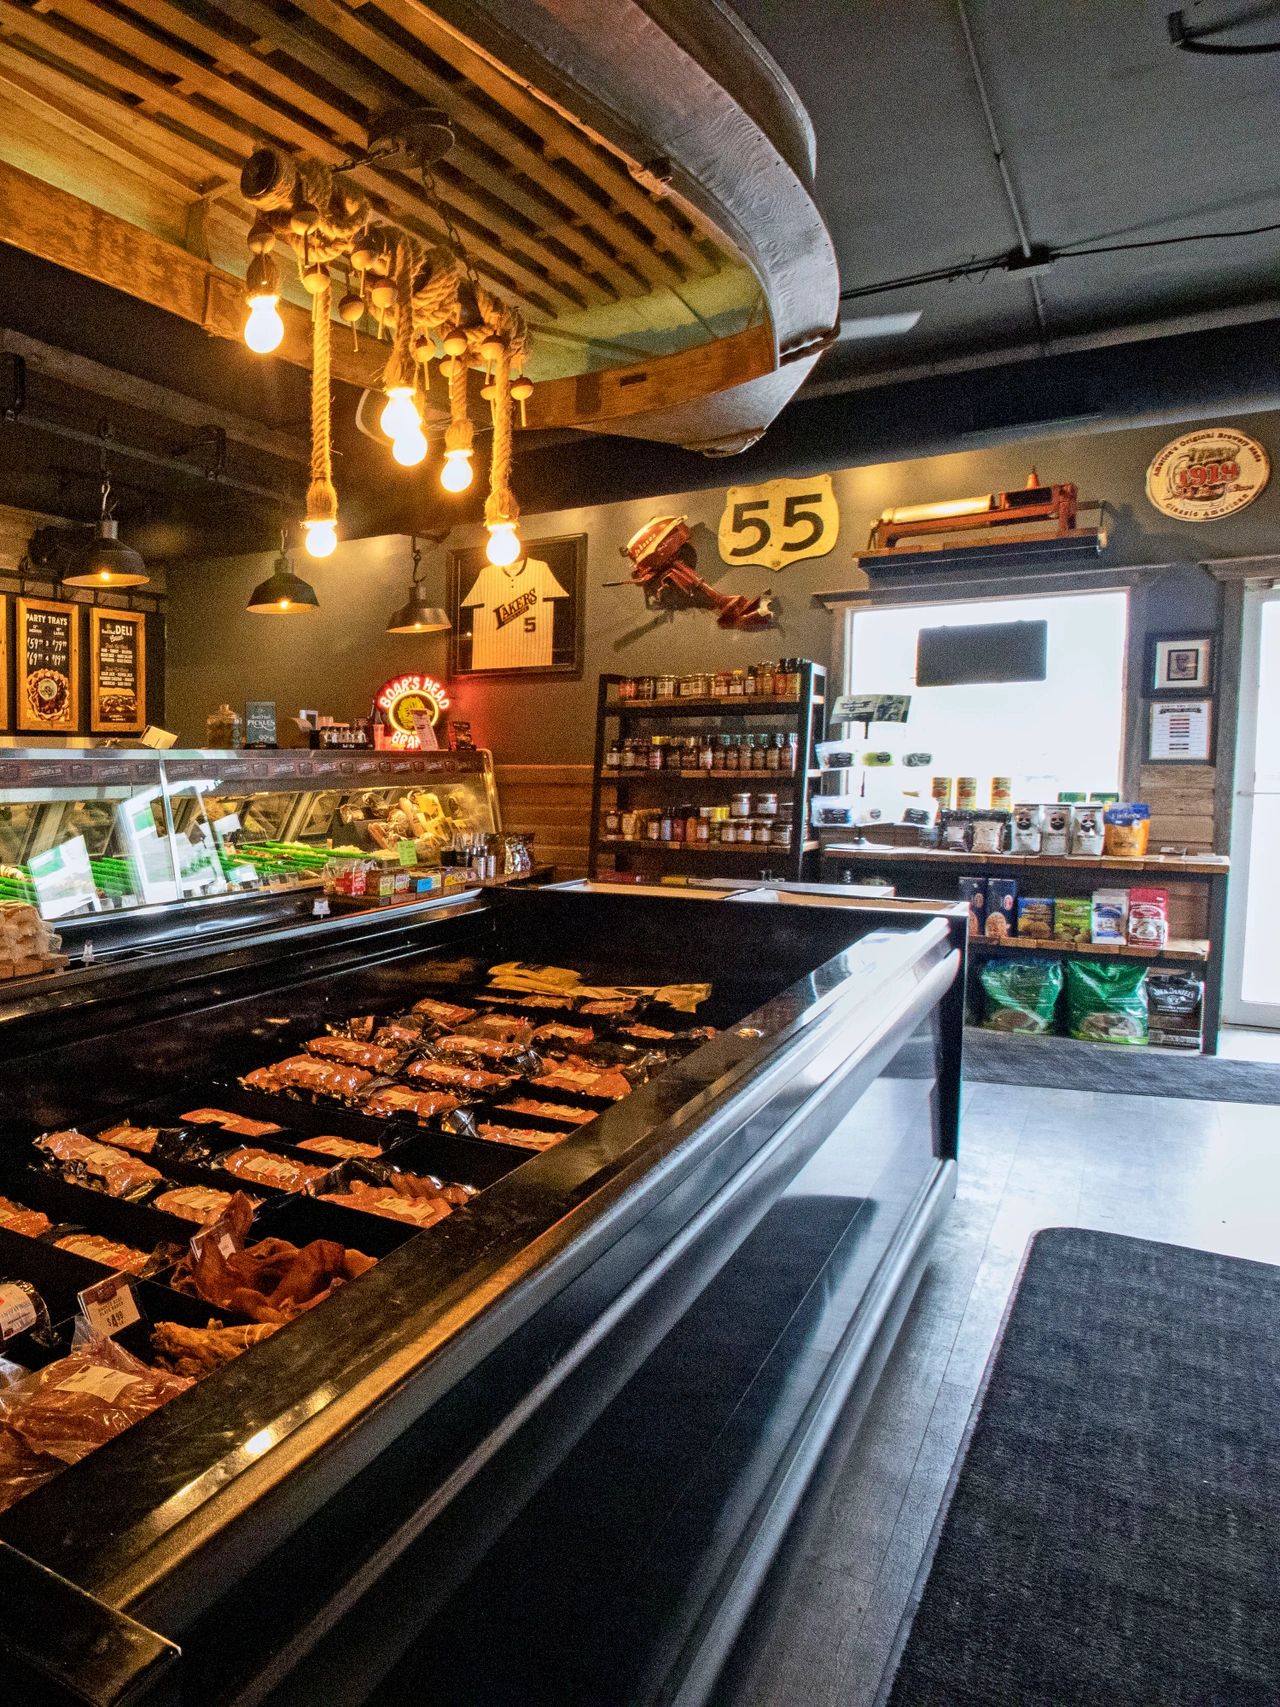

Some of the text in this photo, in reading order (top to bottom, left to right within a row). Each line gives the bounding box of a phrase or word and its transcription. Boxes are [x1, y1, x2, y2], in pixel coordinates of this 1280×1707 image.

[1180, 432, 1215, 447] Original
[1217, 432, 1250, 448] Brewery
[1179, 460, 1239, 488] 1919
[1166, 502, 1198, 517] Classic
[729, 493, 825, 557] 55
[492, 586, 538, 631] LAKERS
[25, 613, 67, 626] PARTY TRAYS
[524, 616, 536, 632] 5
[115, 624, 132, 636] DELI
[380, 676, 450, 710] BOAR'S HEAD
[391, 730, 421, 749] BRAN
